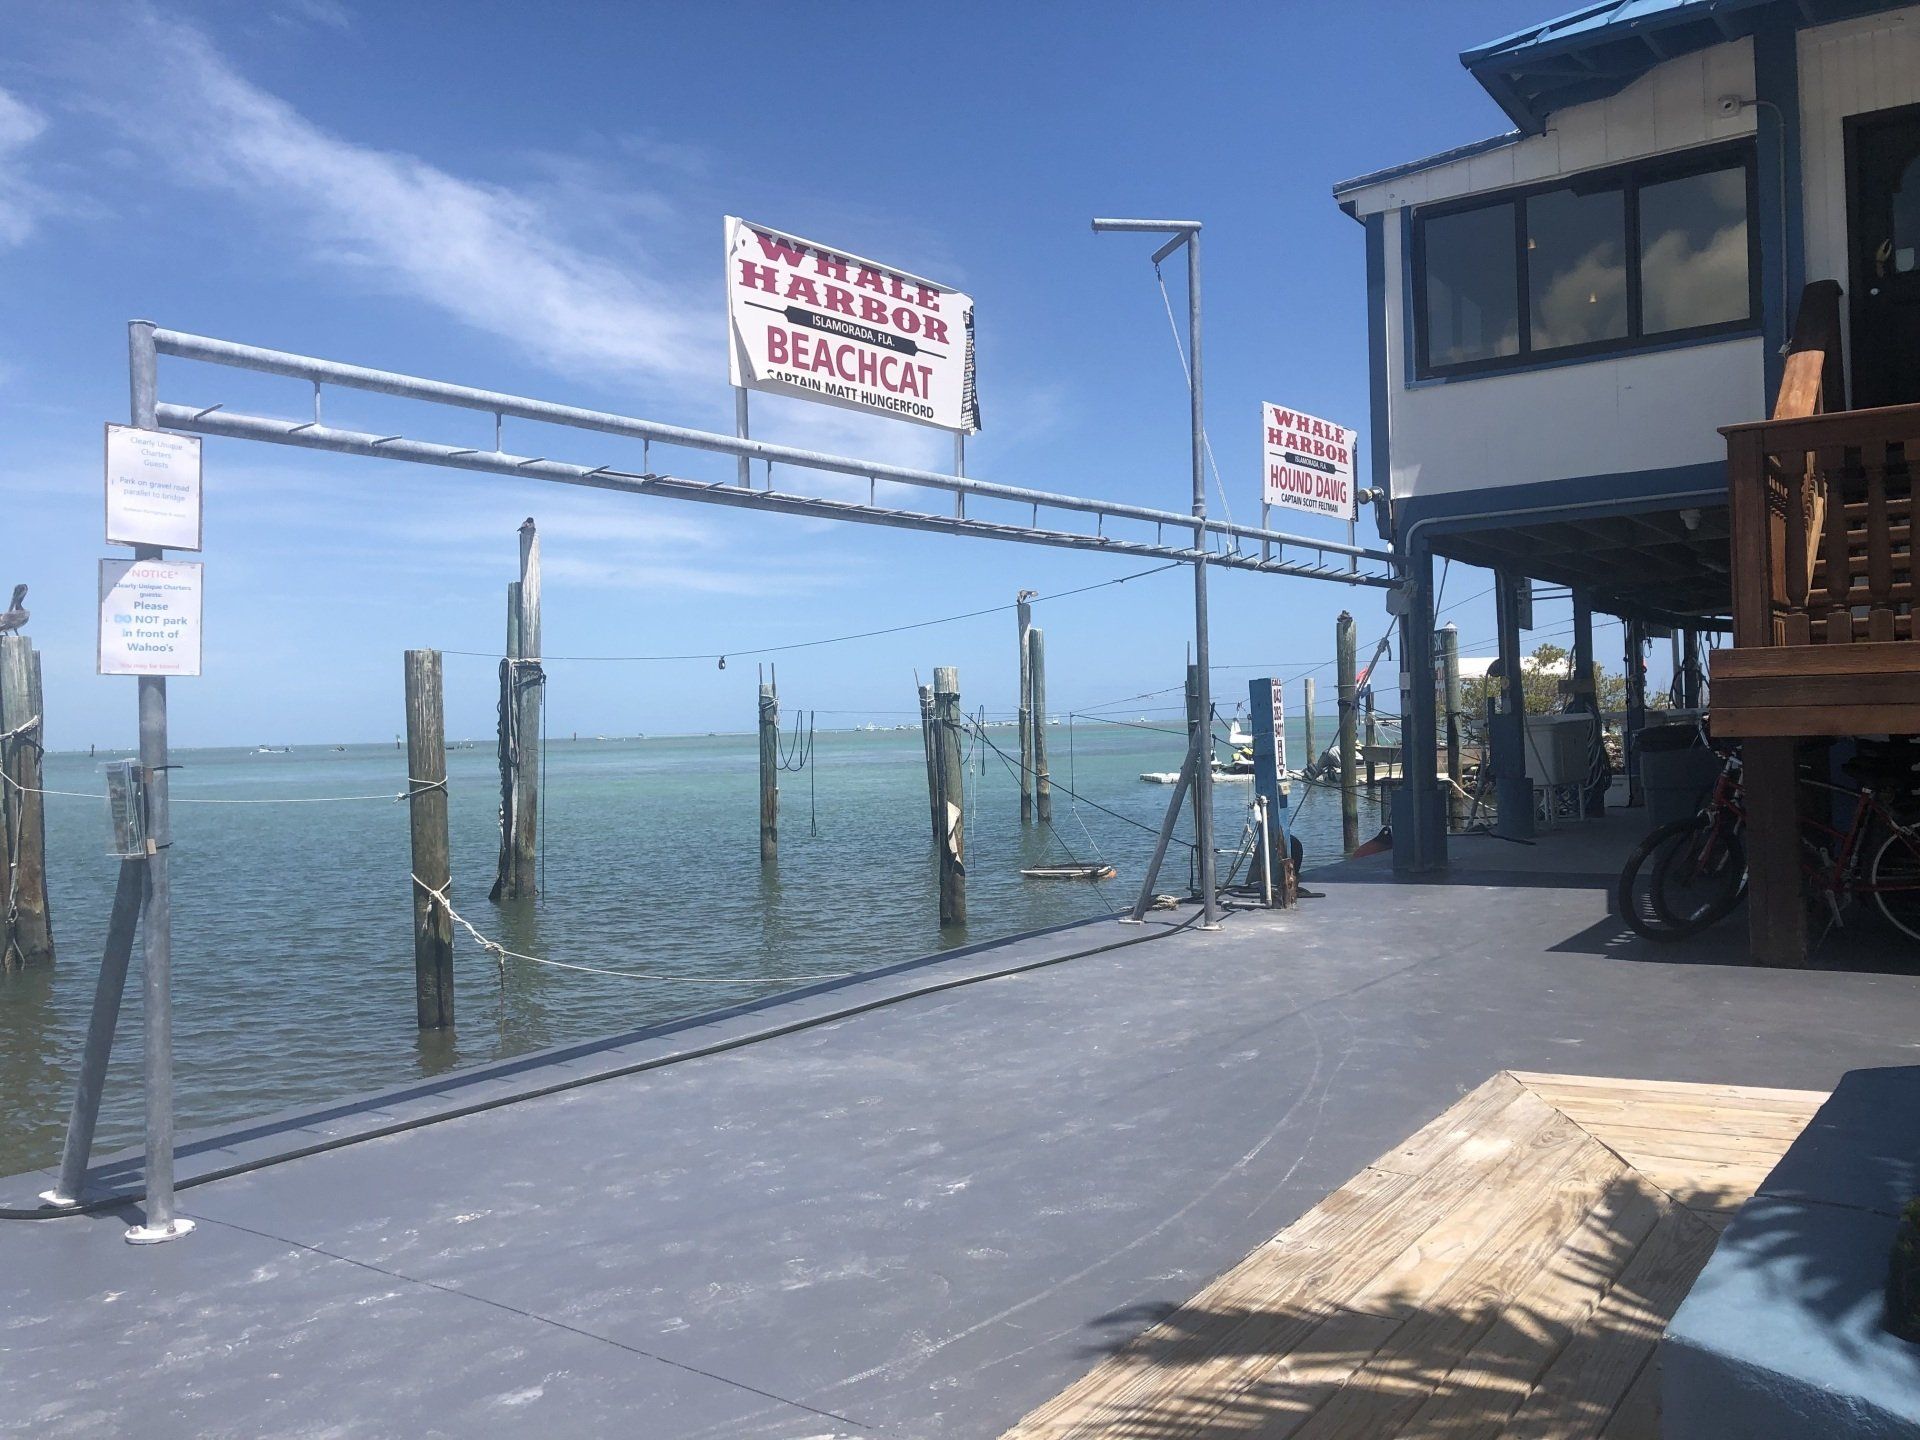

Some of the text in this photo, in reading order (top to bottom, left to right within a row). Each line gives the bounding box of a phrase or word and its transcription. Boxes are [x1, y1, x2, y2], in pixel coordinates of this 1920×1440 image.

[751, 228, 941, 313] WHALE
[738, 258, 950, 345] HARBOR
[812, 314, 896, 347] ISLAMORADA, FLA.
[767, 325, 933, 400] BEACHCAT
[825, 382, 858, 401] MATT
[861, 390, 935, 419] HUNGERFORD
[1273, 407, 1345, 445] WHALE
[130, 436, 183, 452] Clearly Unique
[1267, 426, 1348, 465] HARBOR
[141, 448, 172, 460] Charters
[144, 459, 169, 469] Guests
[119, 476, 190, 493] Park on gravel road
[1270, 463, 1347, 504] HOUND DAWG
[152, 490, 161, 498] to
[1281, 493, 1339, 513] CAPTAIN SCOTT FELTMAN
[138, 583, 163, 591] Unique
[133, 601, 169, 611] Please
[114, 614, 188, 627] DO NOT park
[122, 629, 180, 639] in front of
[127, 642, 175, 653] Wahoo's
